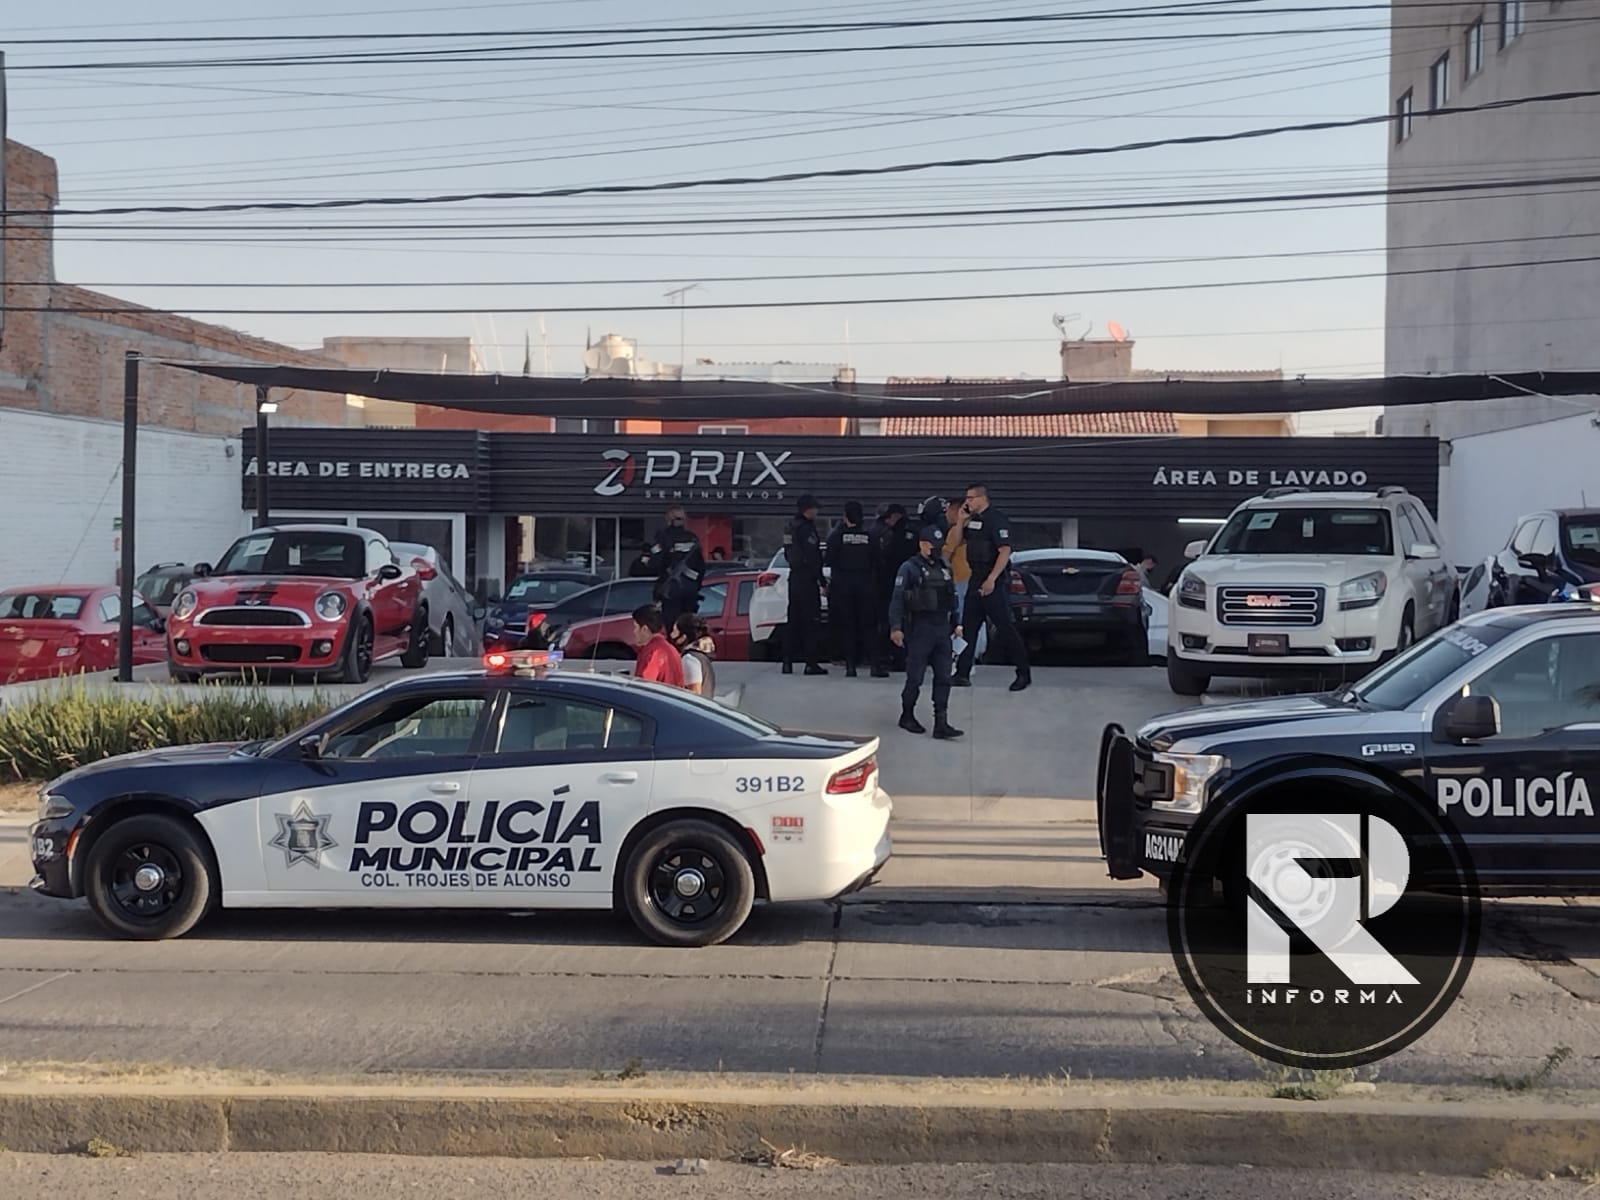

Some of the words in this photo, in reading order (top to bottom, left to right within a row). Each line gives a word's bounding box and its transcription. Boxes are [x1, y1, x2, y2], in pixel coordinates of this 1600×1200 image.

[244, 456, 310, 476] ÁREA
[319, 461, 350, 477] DE
[359, 462, 470, 478] ENTREGA
[644, 450, 792, 485] PRIX
[1152, 466, 1217, 485] ÁREA
[1228, 470, 1259, 485] DE
[1270, 470, 1368, 486] LAVADO
[644, 490, 784, 499] SEMINUEVOS
[735, 776, 805, 793] 391B2
[1437, 771, 1595, 817] POLICÍA
[354, 784, 602, 844] POLICÍA
[349, 847, 602, 872] MUNICIPAL
[361, 873, 400, 888] COL.
[405, 873, 470, 888] TROJES
[476, 873, 498, 888] DE
[503, 873, 571, 888] ALONSO
